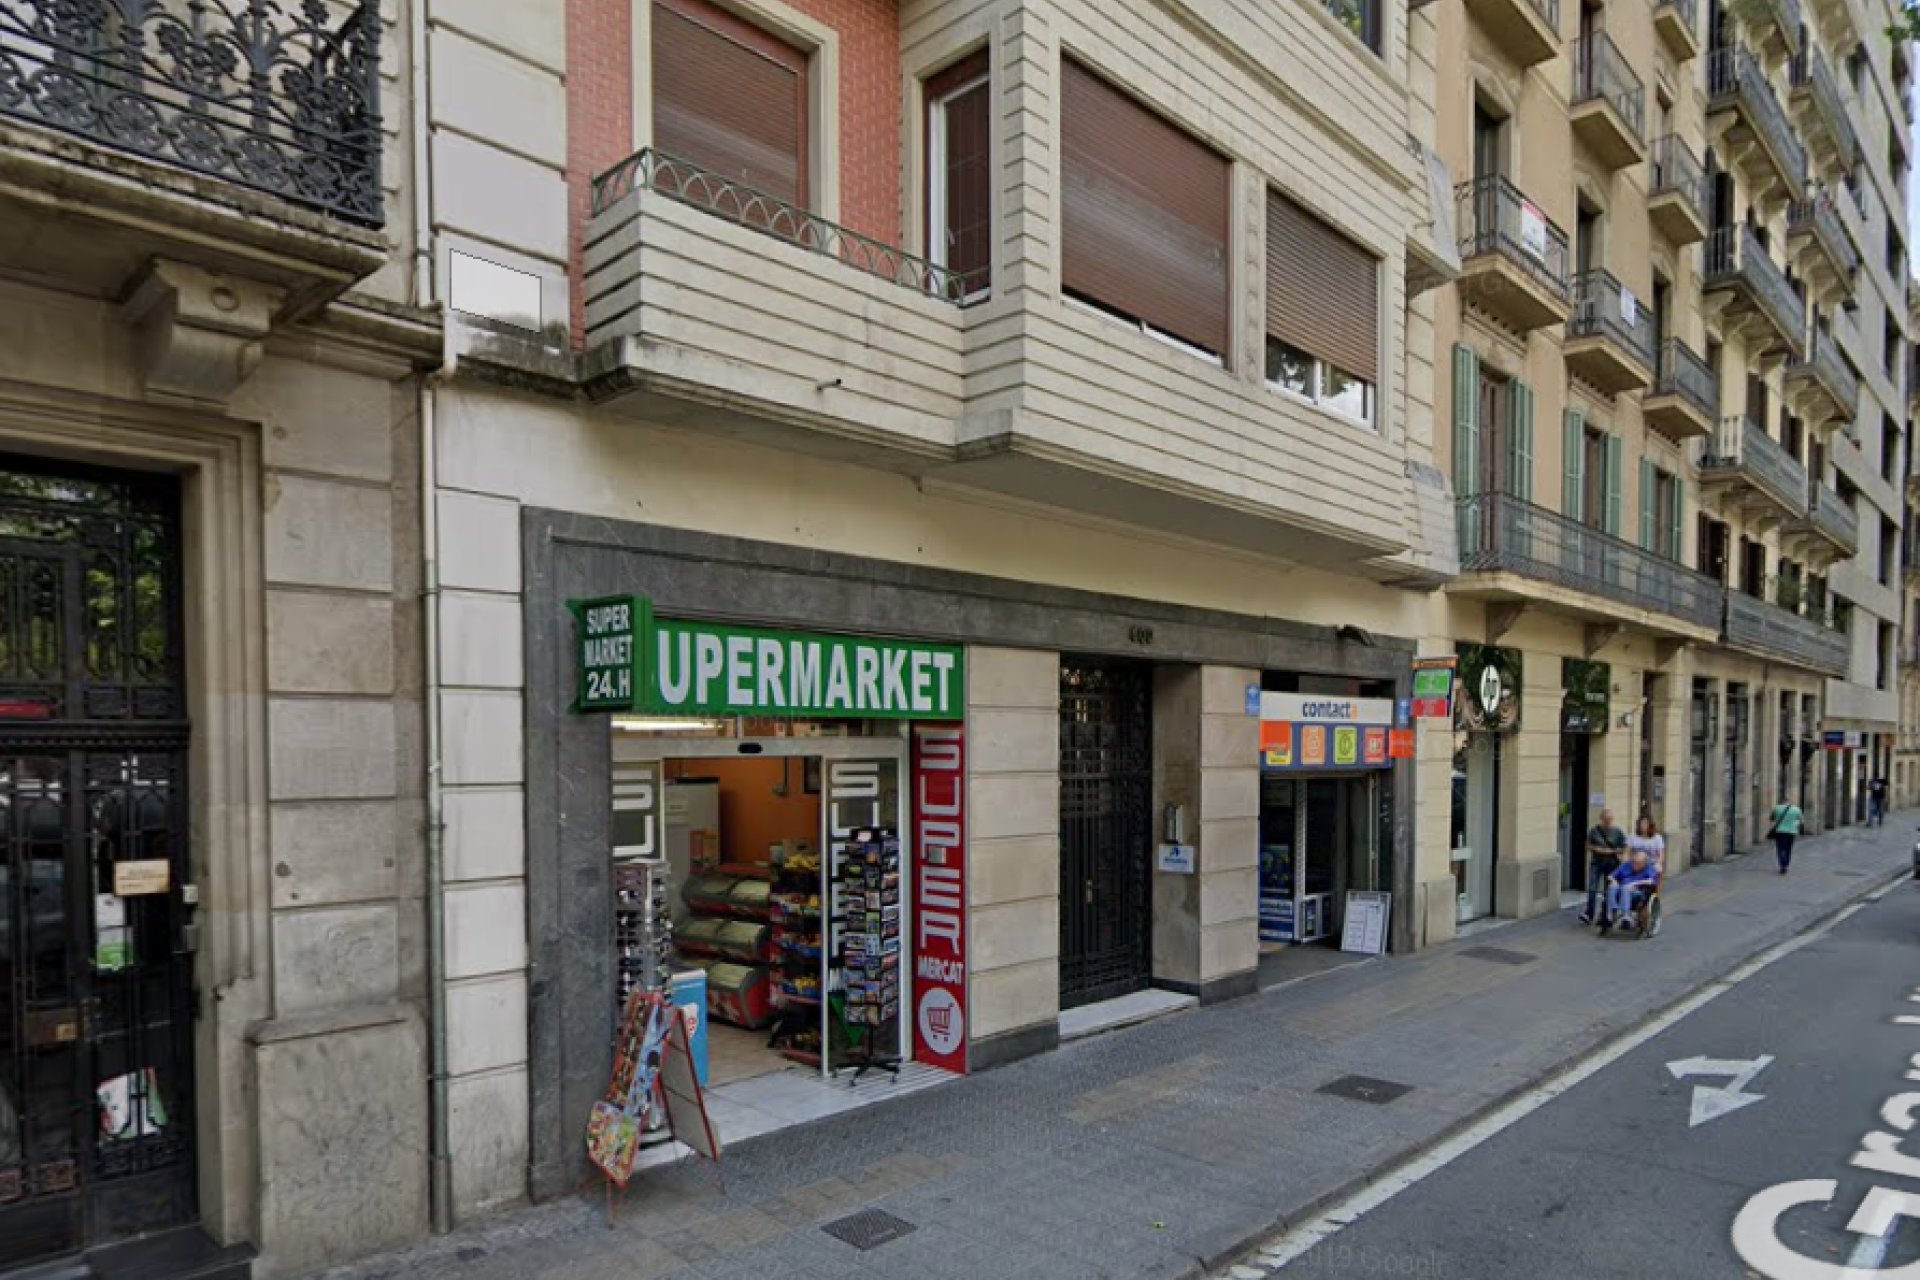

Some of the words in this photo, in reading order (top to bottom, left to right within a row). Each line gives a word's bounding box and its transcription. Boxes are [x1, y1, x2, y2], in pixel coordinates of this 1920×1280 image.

[587, 604, 631, 634] SUPER
[585, 634, 633, 667] MARKET
[587, 668, 631, 700] 24.H
[652, 629, 955, 711] UPERMARKET
[919, 730, 962, 954] SUPER
[917, 955, 964, 984] MERCAT
